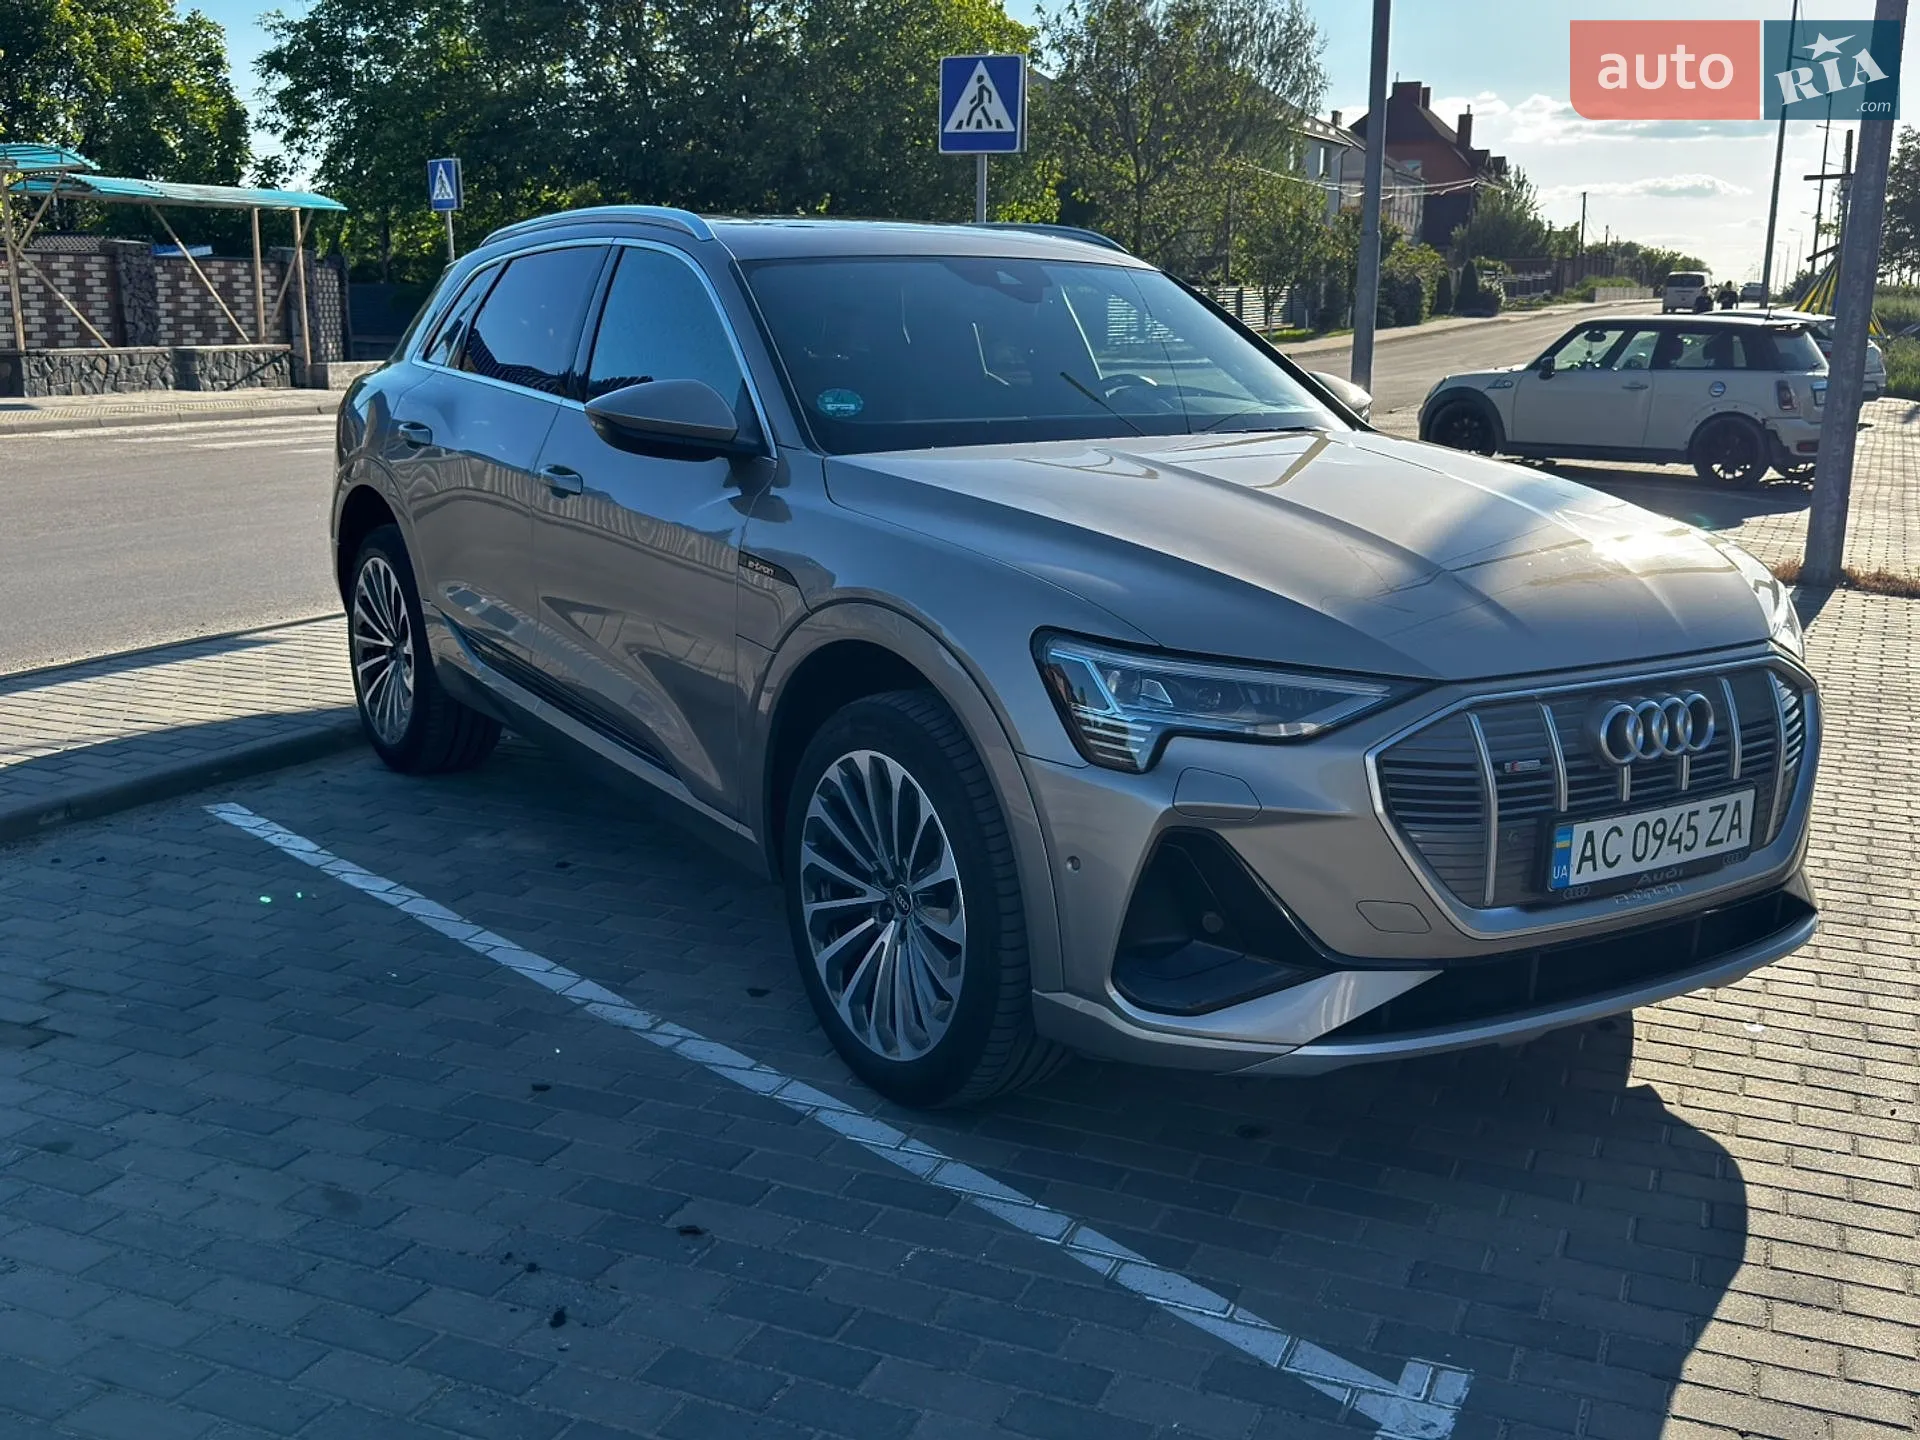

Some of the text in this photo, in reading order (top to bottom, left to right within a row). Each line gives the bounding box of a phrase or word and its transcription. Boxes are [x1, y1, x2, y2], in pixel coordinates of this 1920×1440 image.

[1575, 800, 1742, 875] AC 0945 ZA
[1553, 866, 1568, 880] UA
